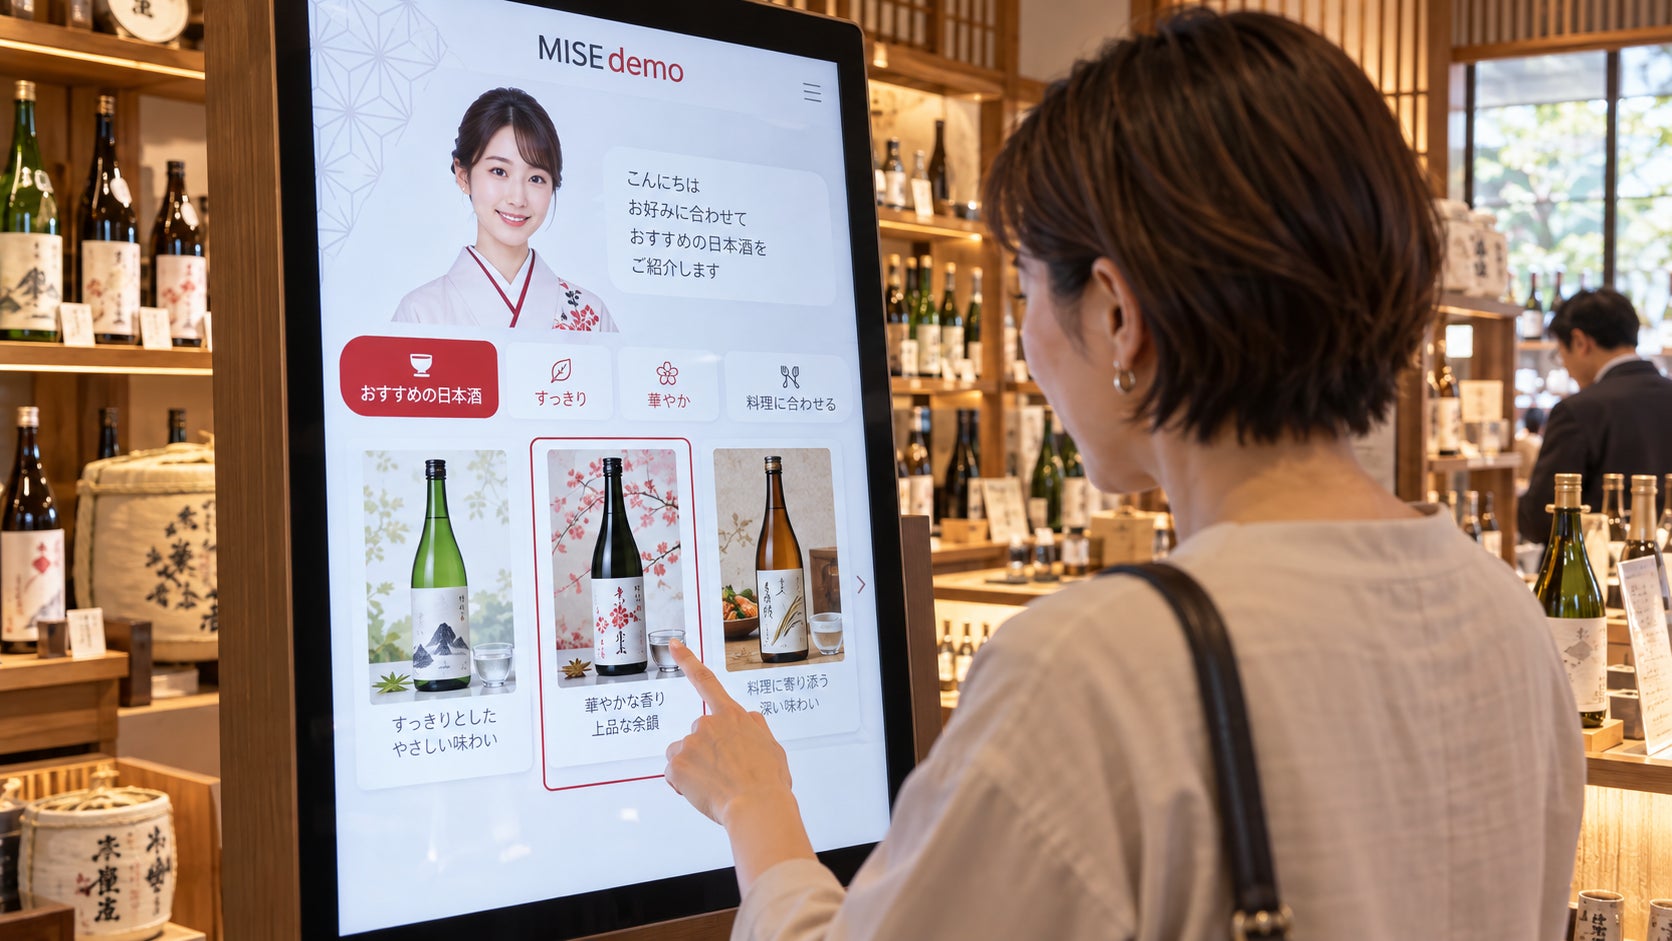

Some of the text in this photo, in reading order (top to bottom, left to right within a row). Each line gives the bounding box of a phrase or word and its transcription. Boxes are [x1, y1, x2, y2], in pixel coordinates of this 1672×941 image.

[538, 34, 684, 83] MISE demo
[627, 170, 701, 194] こんにちは
[628, 199, 748, 227] お好みに合わせて
[630, 227, 767, 257] おすすめの日本酒を
[632, 257, 720, 280] ご紹介します
[360, 384, 483, 405] おすすめの日本酒
[534, 390, 587, 407] すっきり
[647, 392, 691, 409] 華やか
[746, 394, 837, 412] 料理に合わせる
[747, 673, 829, 696] 料理に寄り添う
[584, 691, 665, 714] 華やかな香り
[760, 698, 820, 716] 深い味わい
[392, 707, 497, 733] すっきりとした
[392, 733, 498, 758] やさしい味わい
